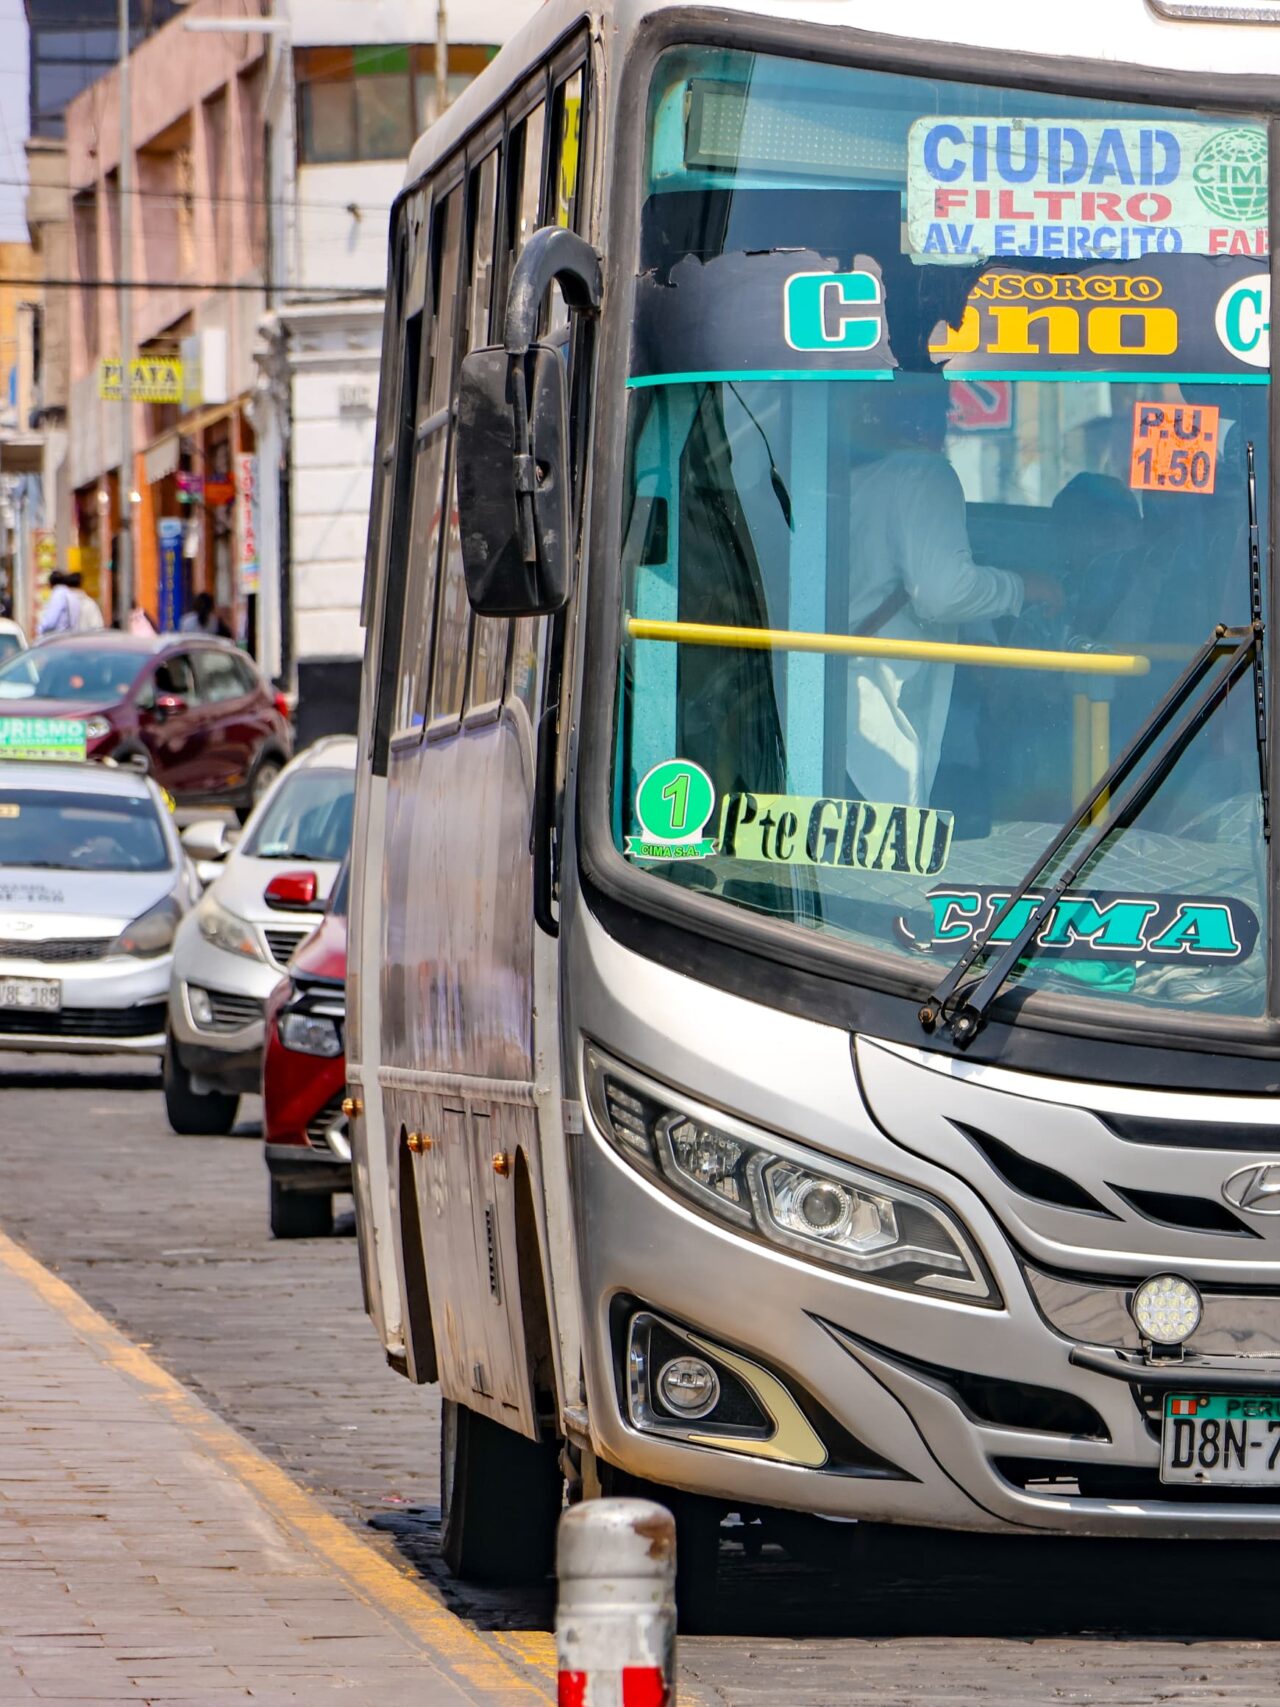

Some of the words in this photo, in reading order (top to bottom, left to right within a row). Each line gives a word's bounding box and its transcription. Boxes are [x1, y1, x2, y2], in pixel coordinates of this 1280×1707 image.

[923, 124, 1182, 186] CIUDAD
[1192, 164, 1263, 184] CIM
[934, 188, 1173, 222] FILTRO
[923, 222, 979, 254] AV.
[994, 224, 1183, 260] EJERCITO
[1140, 407, 1213, 442] P.U.
[1137, 448, 1210, 488] 1.50
[663, 773, 690, 828] 1
[641, 844, 672, 857] CIMA
[805, 799, 950, 875] GRAU
[922, 893, 1241, 956] CIMA
